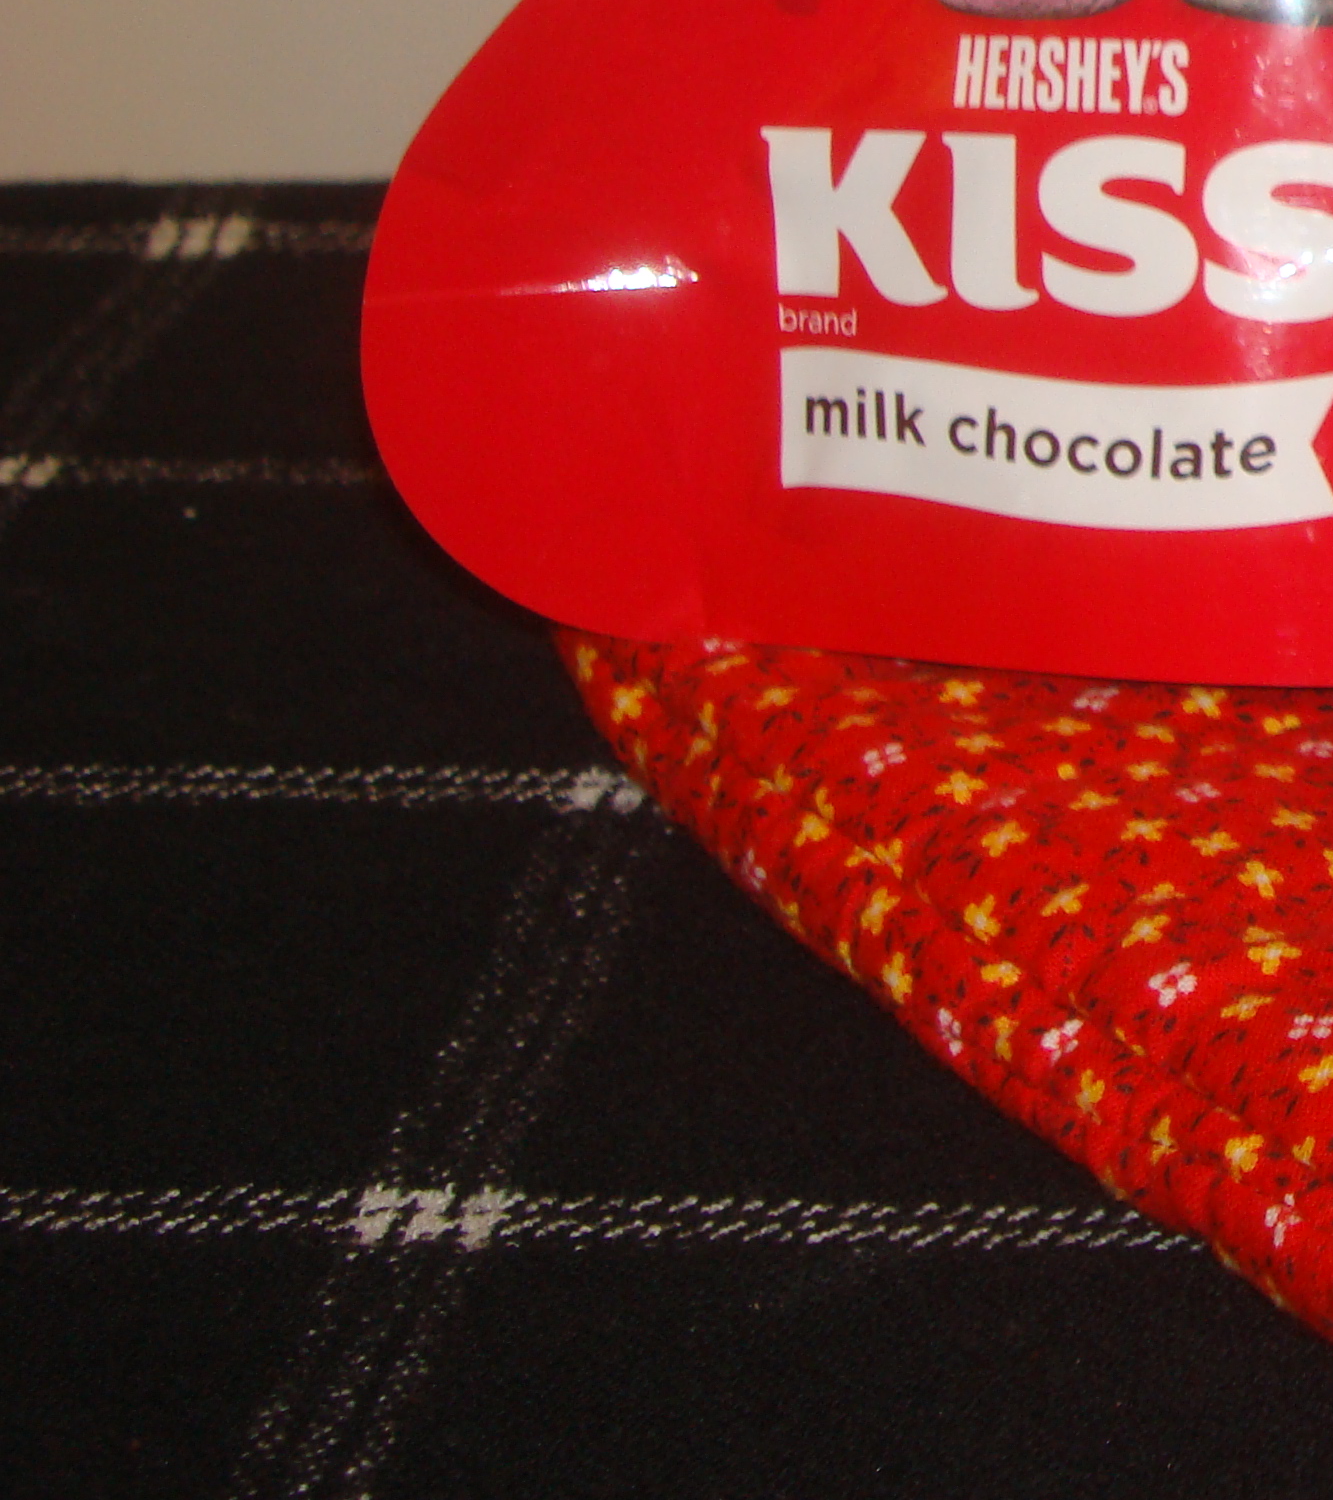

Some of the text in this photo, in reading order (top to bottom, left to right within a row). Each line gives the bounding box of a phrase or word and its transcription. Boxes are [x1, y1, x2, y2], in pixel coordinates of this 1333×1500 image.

[953, 34, 1191, 117] HERSHEY'S
[778, 302, 858, 337] brand
[804, 386, 1278, 482] milk chocolate
